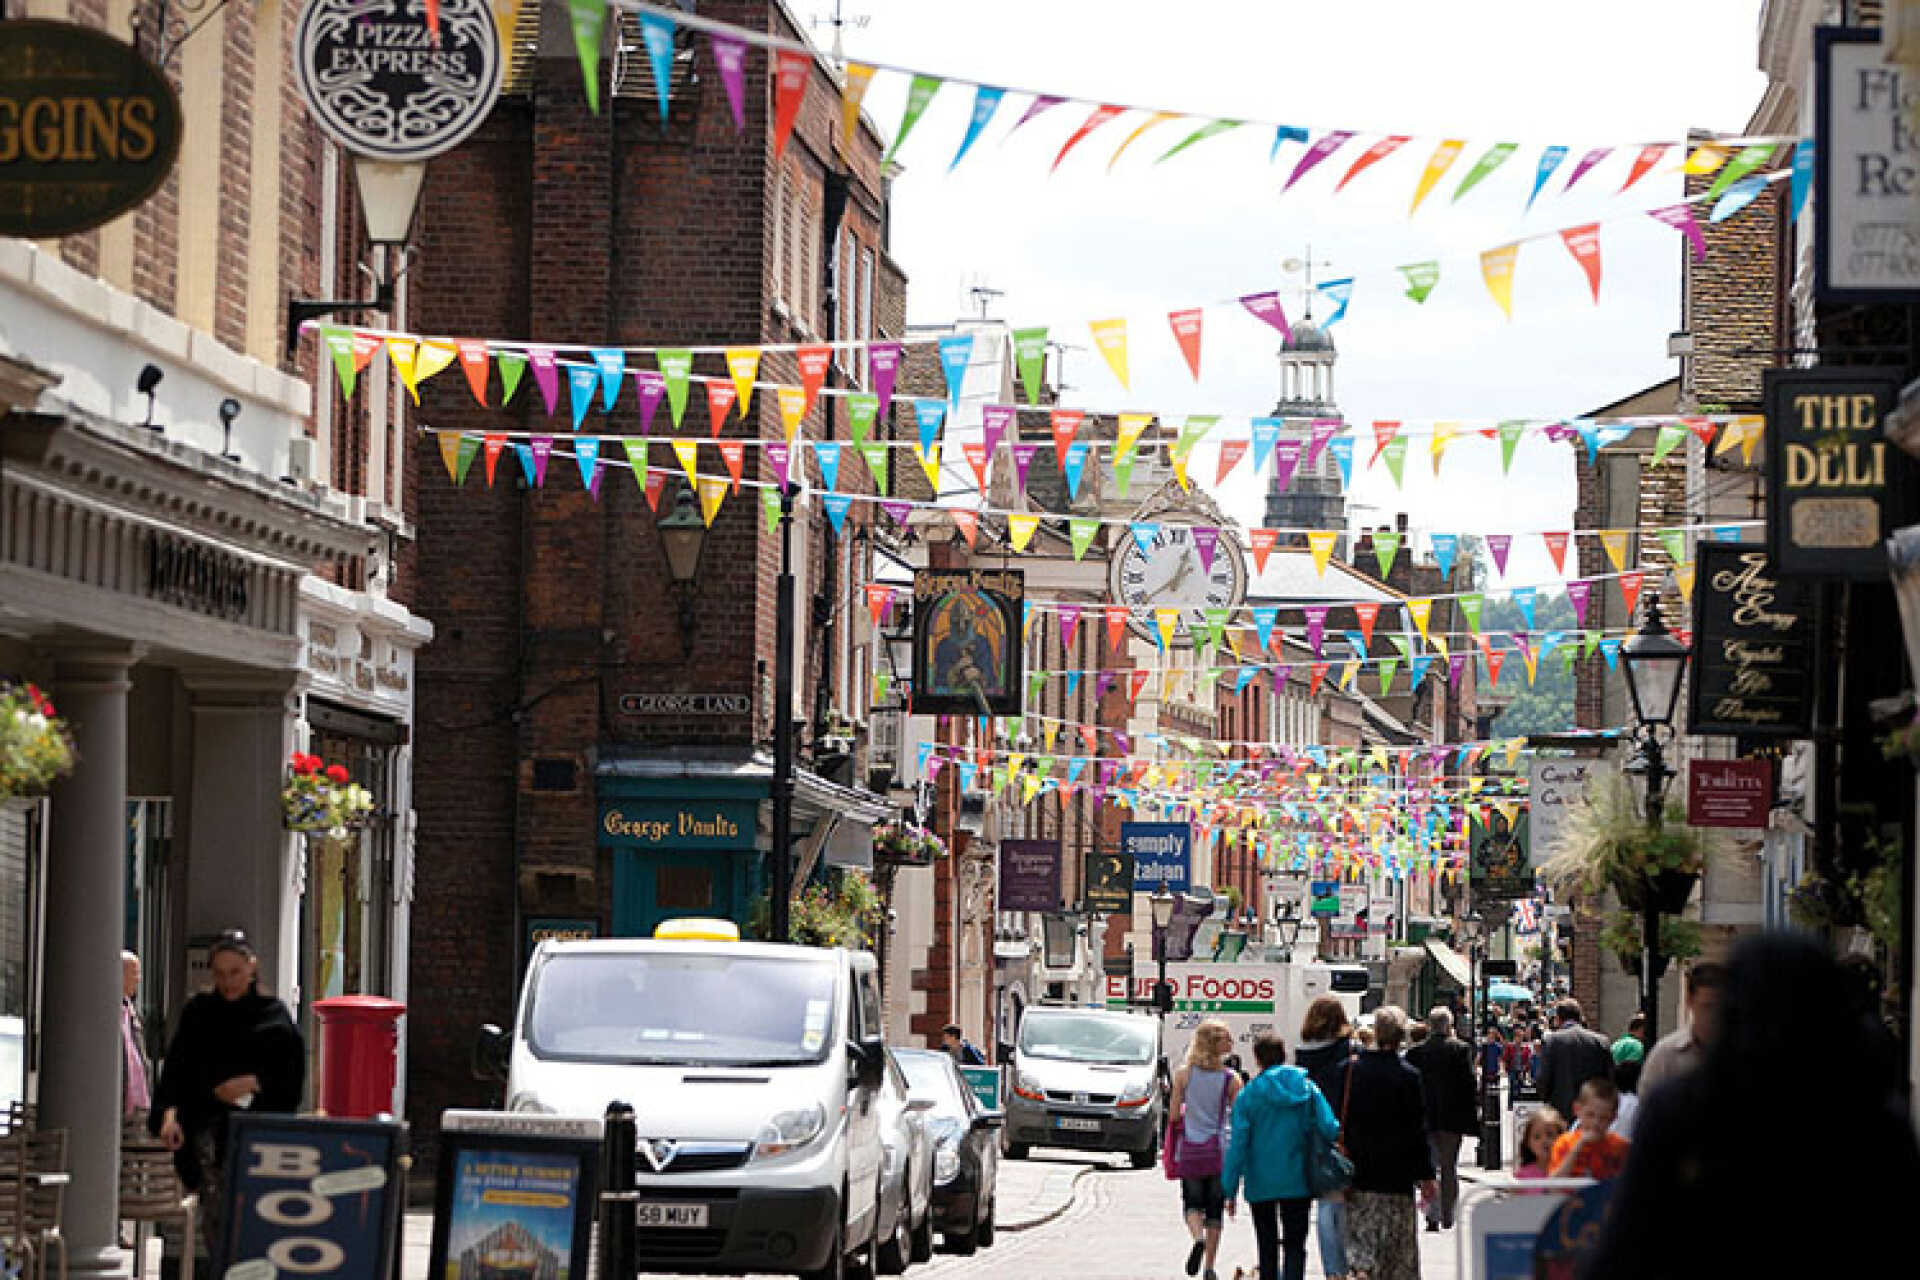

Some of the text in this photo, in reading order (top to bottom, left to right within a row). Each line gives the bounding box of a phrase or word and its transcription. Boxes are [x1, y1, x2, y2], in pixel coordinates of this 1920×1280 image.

[331, 49, 467, 73] EXPRESS
[1793, 393, 1876, 430] THE
[1785, 442, 1887, 487] DELI
[640, 696, 746, 712] GEORGE LANE
[604, 810, 738, 842] George Vaults
[1127, 832, 1185, 856] simply
[1133, 860, 1184, 881] talian
[1187, 975, 1275, 999] FOODS
[665, 1206, 700, 1225] MUY
